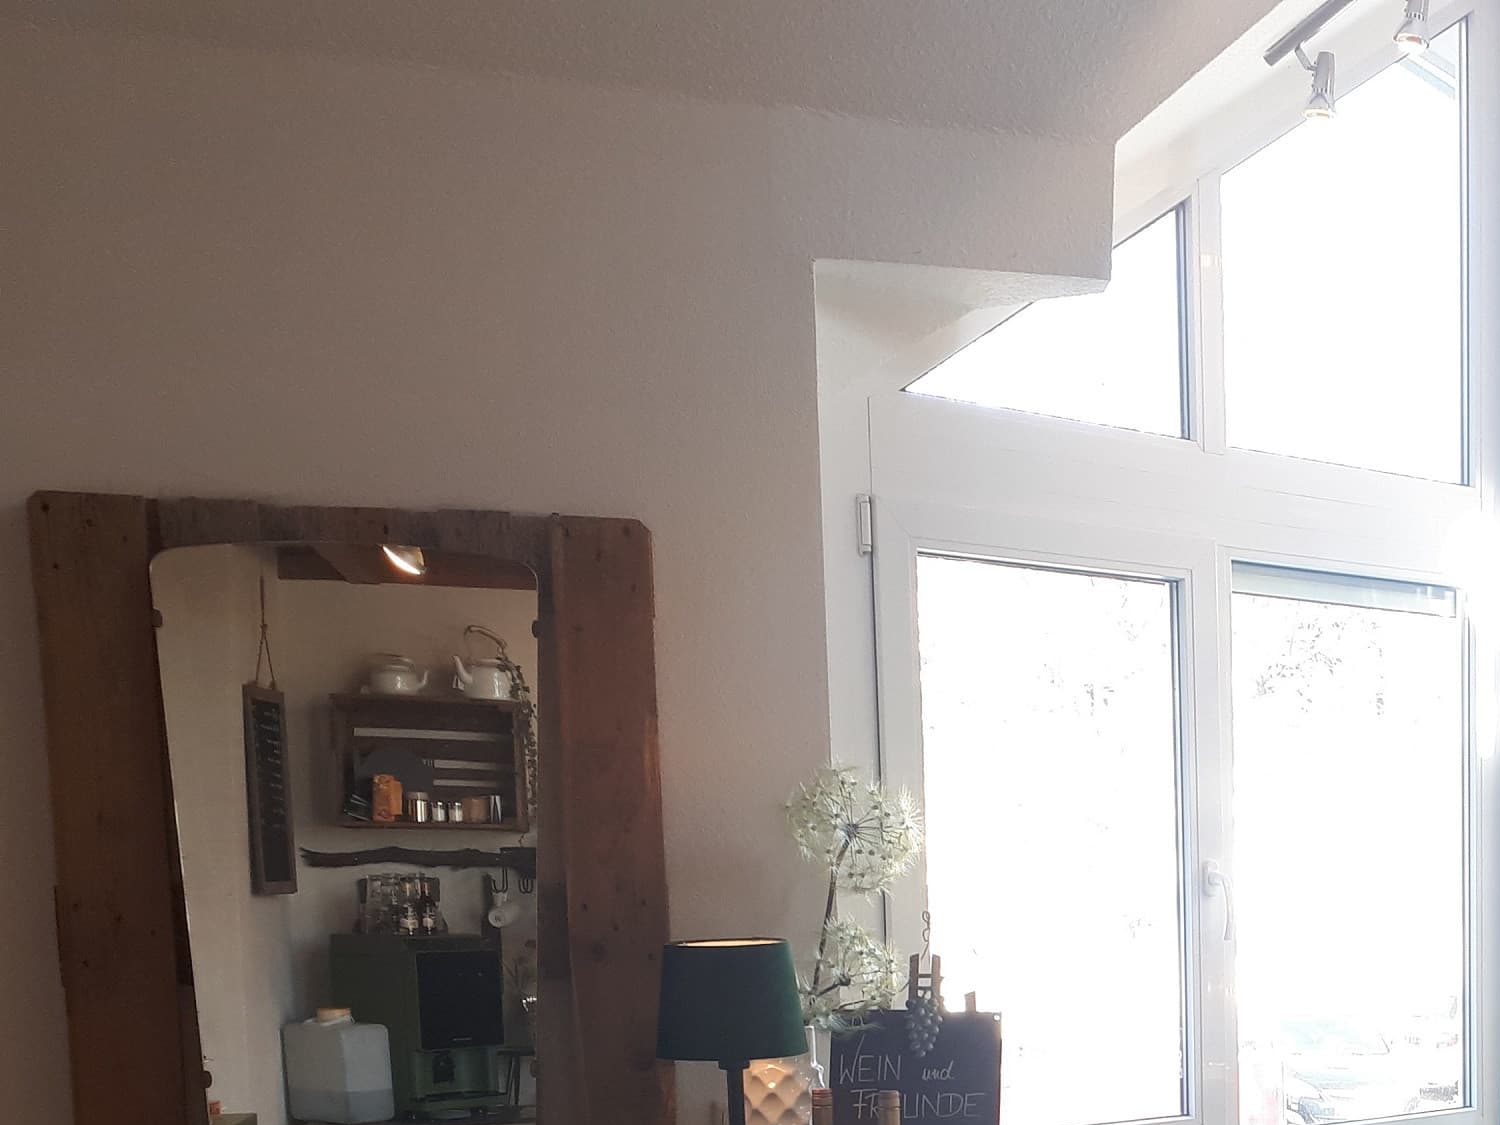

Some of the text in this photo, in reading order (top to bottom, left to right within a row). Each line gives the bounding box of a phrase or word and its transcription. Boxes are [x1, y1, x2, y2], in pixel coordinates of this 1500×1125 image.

[839, 1034, 955, 1085] WEIN und
[850, 1088, 986, 1119] FRUNDE
